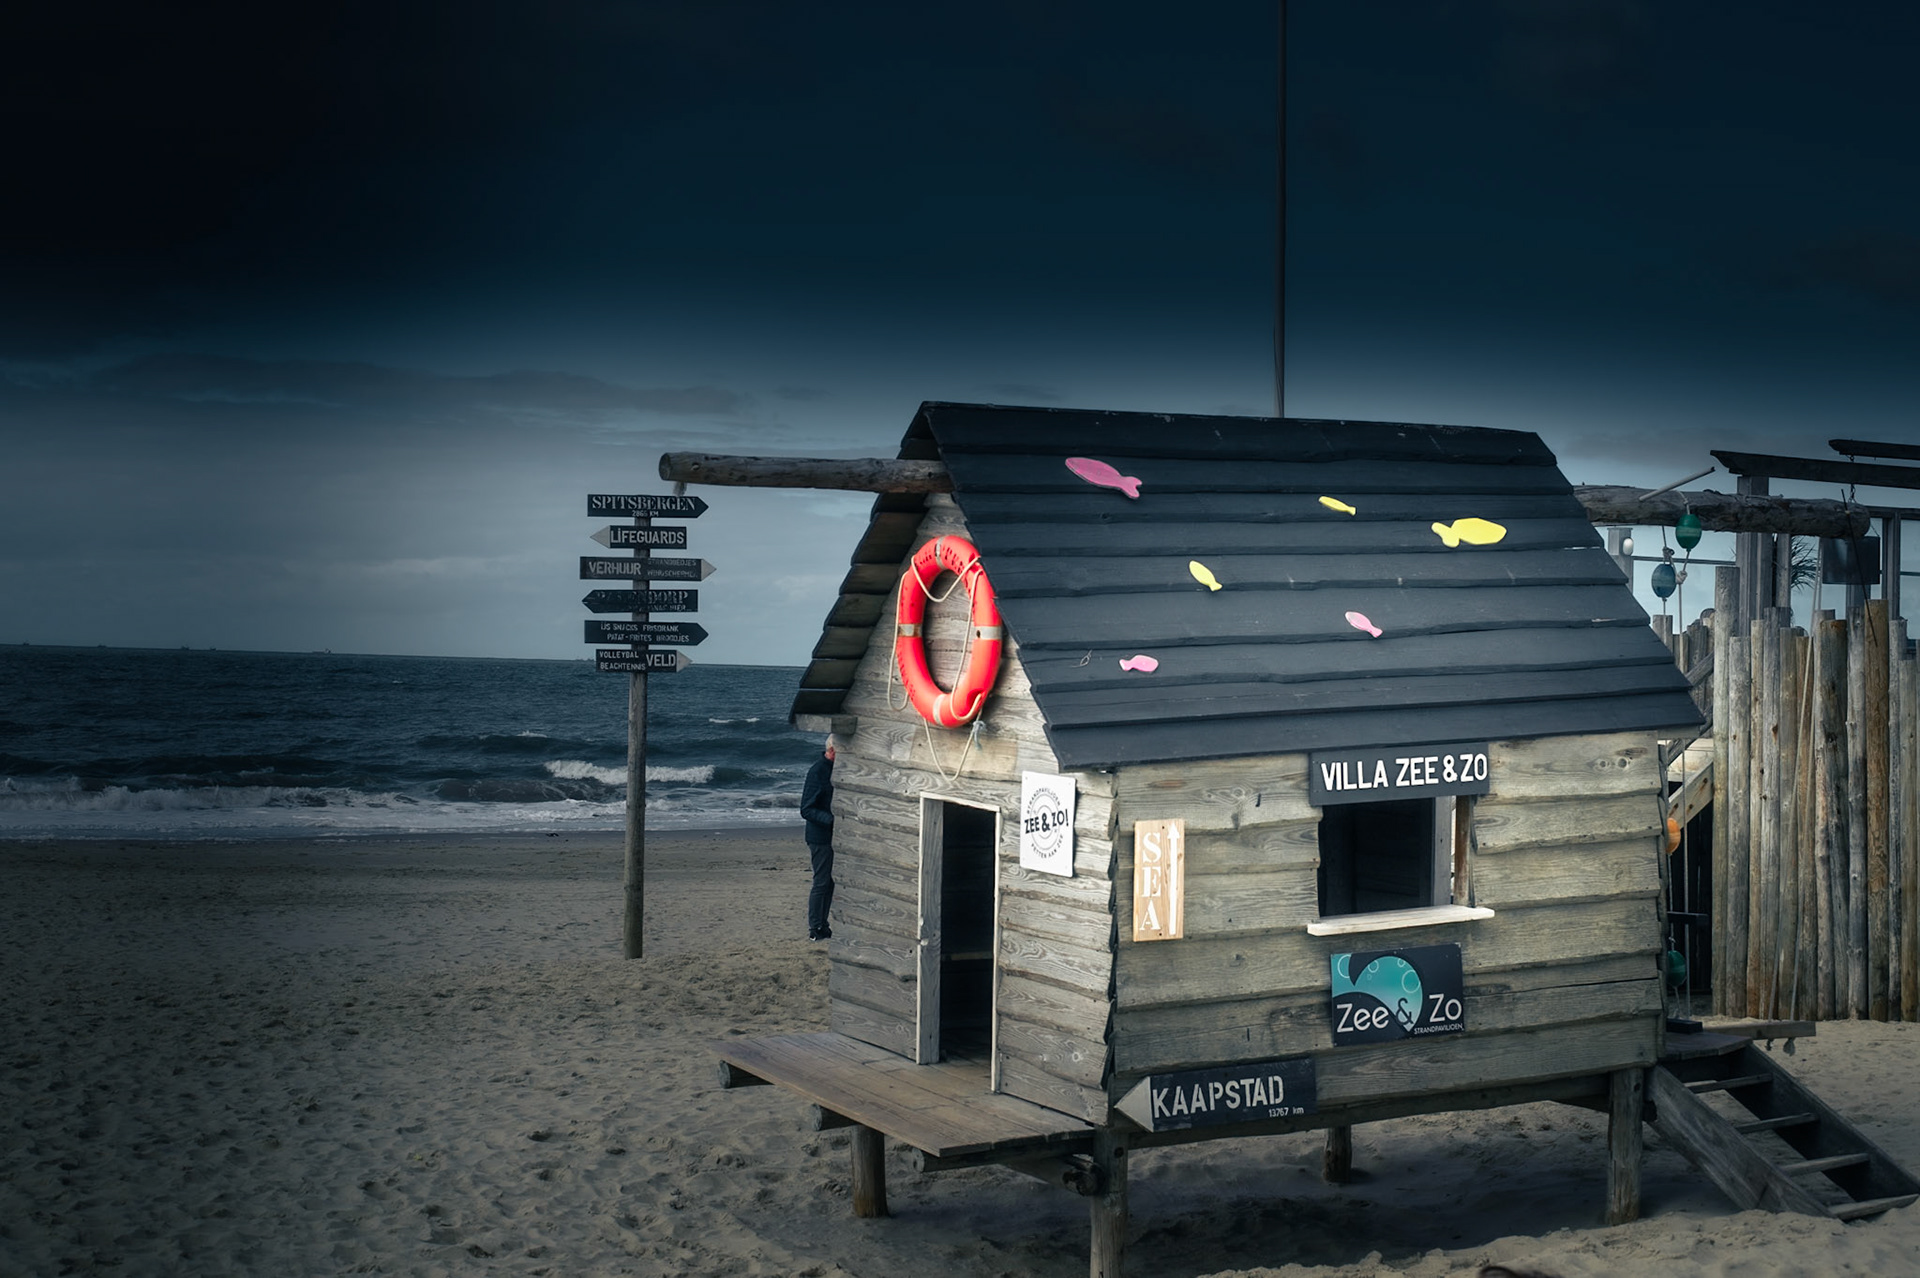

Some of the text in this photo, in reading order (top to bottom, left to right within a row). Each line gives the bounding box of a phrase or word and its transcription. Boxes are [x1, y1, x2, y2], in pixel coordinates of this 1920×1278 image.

[592, 496, 696, 511] SPITSBERGEN
[589, 561, 642, 575] VERHUUR
[613, 623, 638, 631] SNACKS
[643, 624, 679, 632] FRISDRANK
[599, 651, 639, 659] VOLLEYBAL
[646, 654, 676, 667] VELD
[600, 662, 646, 671] BEACHTENNIS
[1321, 753, 1488, 792] VILLA ZEE & ZO
[1024, 808, 1069, 834] ZEE & ZO!
[1031, 843, 1047, 859] PETTEN
[1048, 848, 1057, 858] AAN
[1139, 832, 1162, 931] SEA
[1336, 993, 1462, 1033] Zee & Zo
[1414, 1023, 1464, 1035] STRANDPAVILJOEN
[1152, 1075, 1284, 1119] KAAPSTAD
[1268, 1106, 1305, 1118] 13767 km
